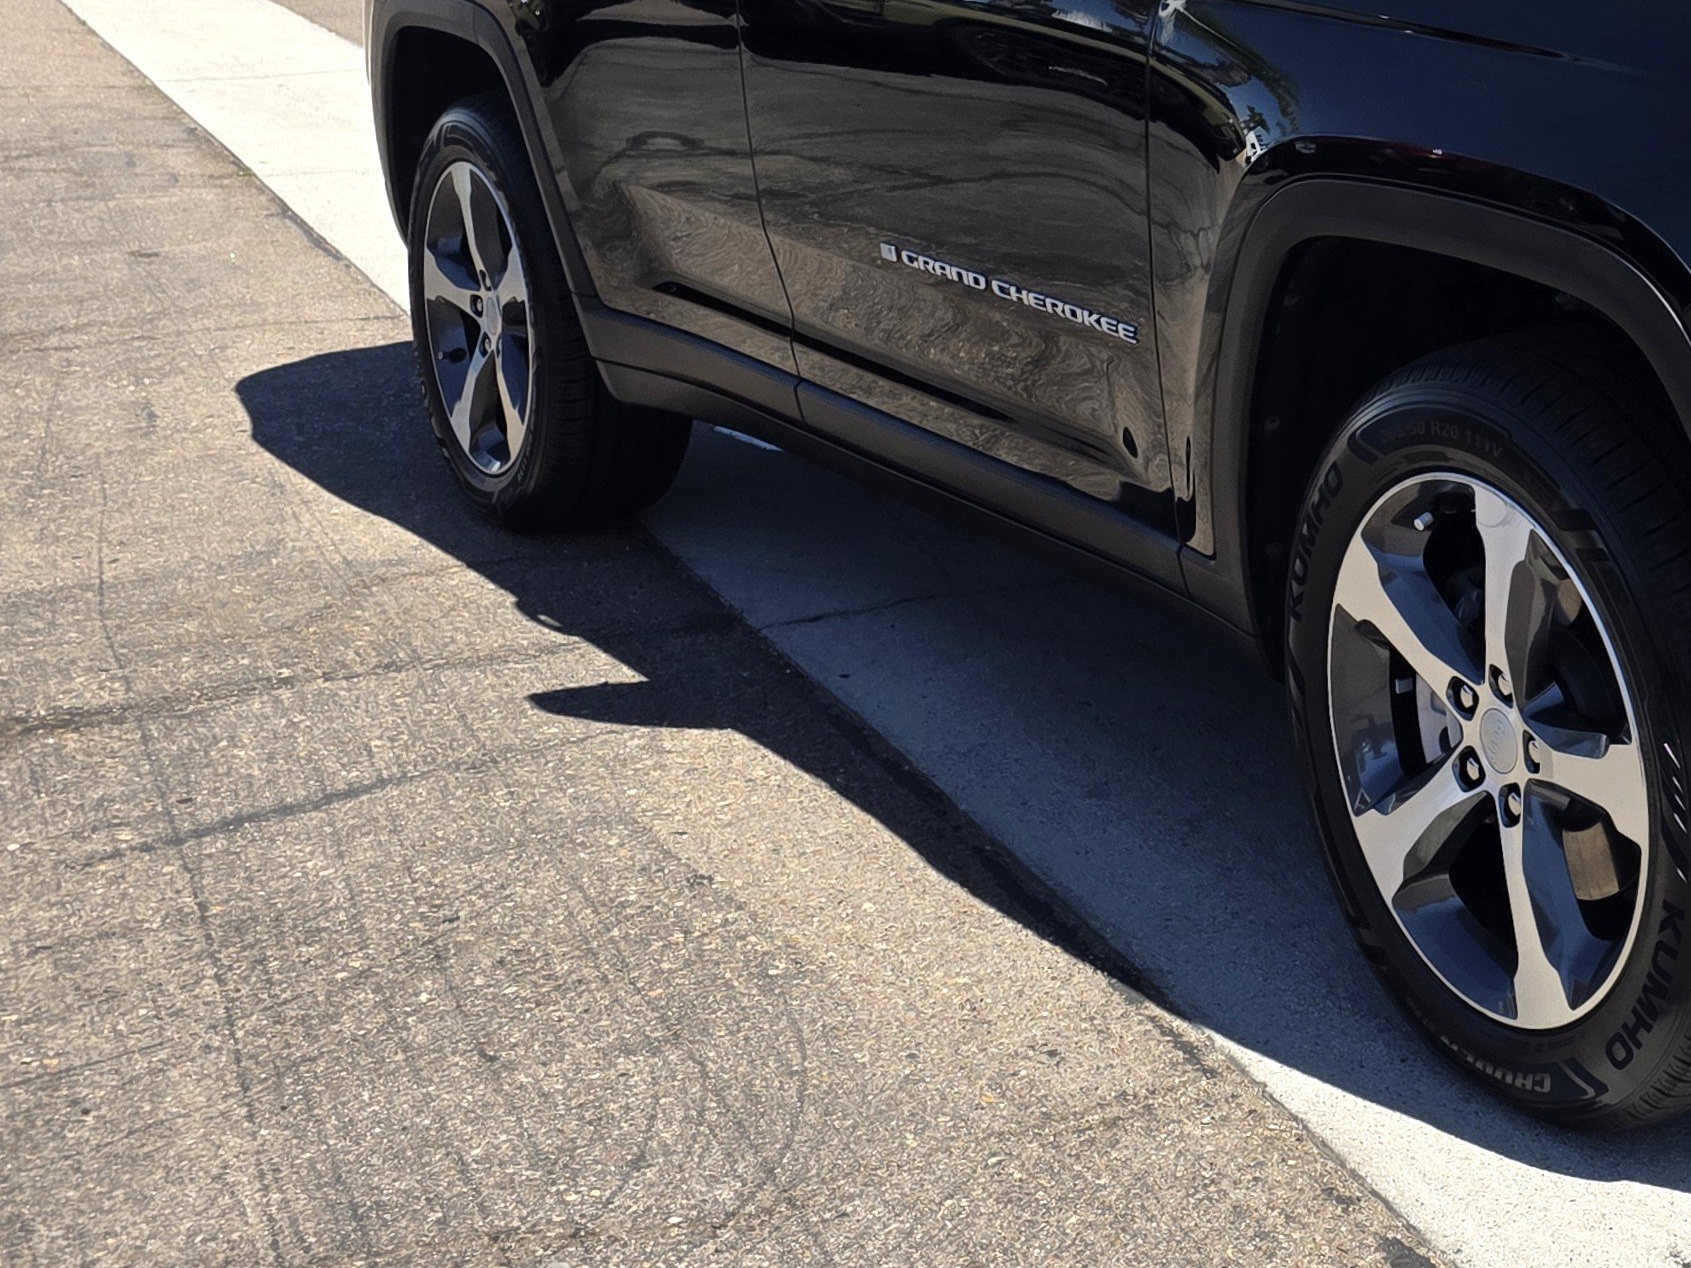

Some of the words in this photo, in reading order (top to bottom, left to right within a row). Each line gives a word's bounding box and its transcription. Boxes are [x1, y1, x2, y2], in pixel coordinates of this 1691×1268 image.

[901, 250, 987, 291] GRAND
[991, 279, 1140, 345] CHEROKEE
[1605, 898, 1686, 1071] KUMHO
